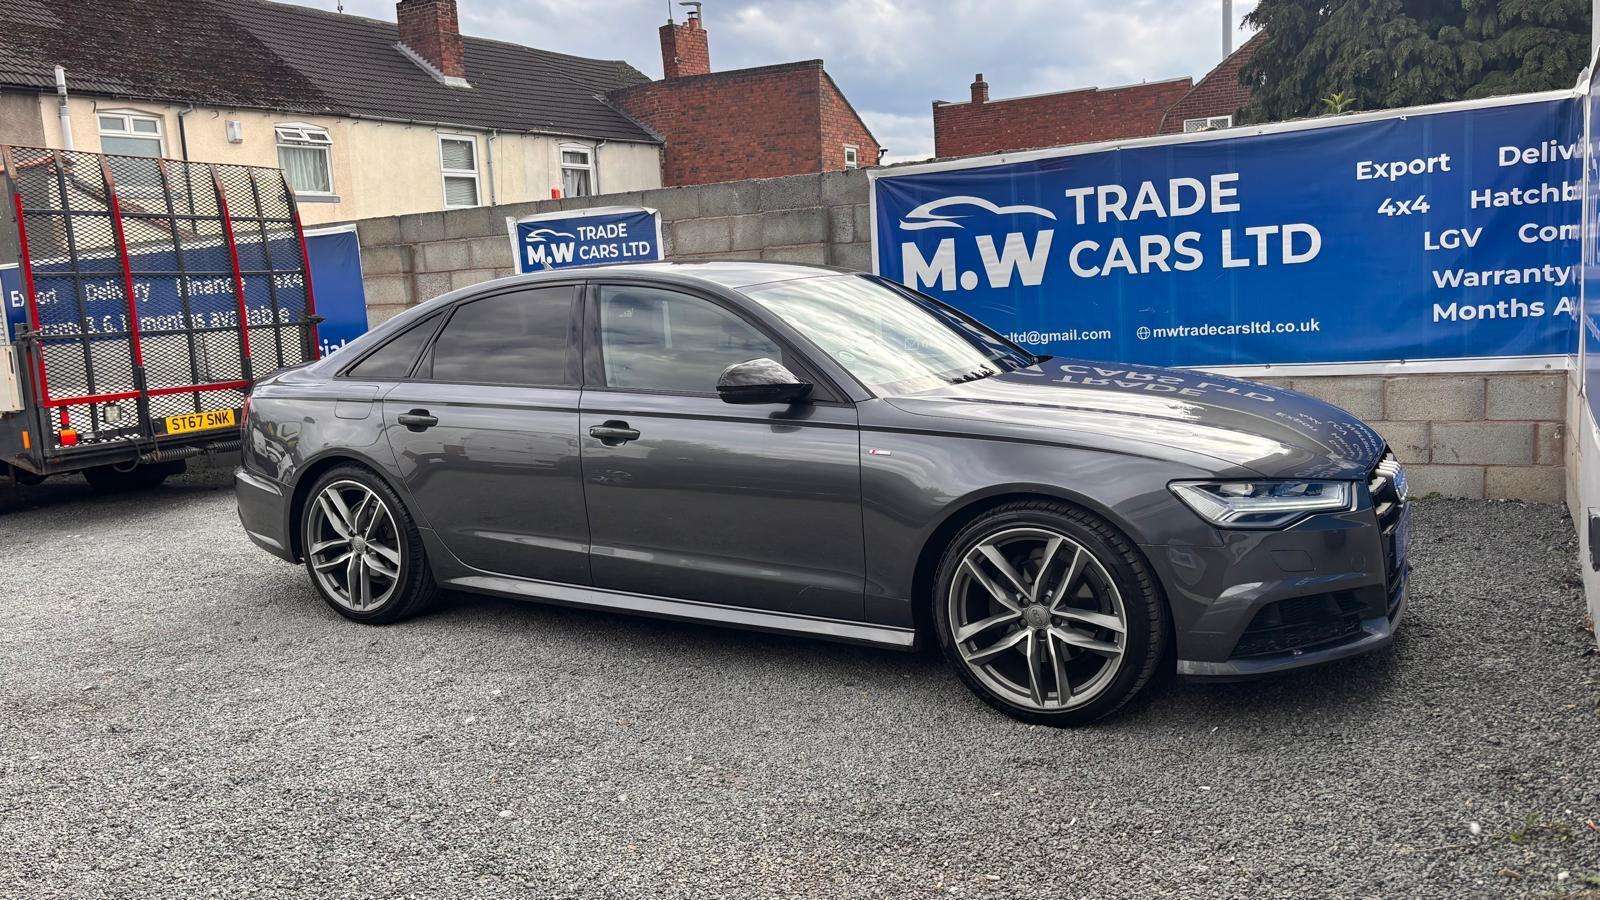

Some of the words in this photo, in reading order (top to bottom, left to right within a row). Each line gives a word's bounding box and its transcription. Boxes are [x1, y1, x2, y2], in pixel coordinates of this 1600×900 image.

[1356, 153, 1451, 181] Export
[1065, 172, 1241, 225] TRADE
[1377, 194, 1430, 216] 4x4
[577, 223, 628, 241] TRADE
[1424, 227, 1483, 251] LGV
[526, 242, 575, 266] M.W
[579, 243, 619, 260] CARS
[622, 241, 650, 257] LTD
[901, 229, 1055, 291] M.W
[1069, 231, 1204, 278] CARS
[1221, 222, 1322, 268] LTD
[1432, 264, 1571, 289] Warranty
[85, 279, 150, 302] Delivry
[1433, 298, 1545, 323] Months
[1553, 296, 1575, 318] A
[1153, 318, 1320, 338] mwtradecarsltd.co.uk
[171, 415, 203, 430] ST67
[206, 411, 230, 426] SNK
